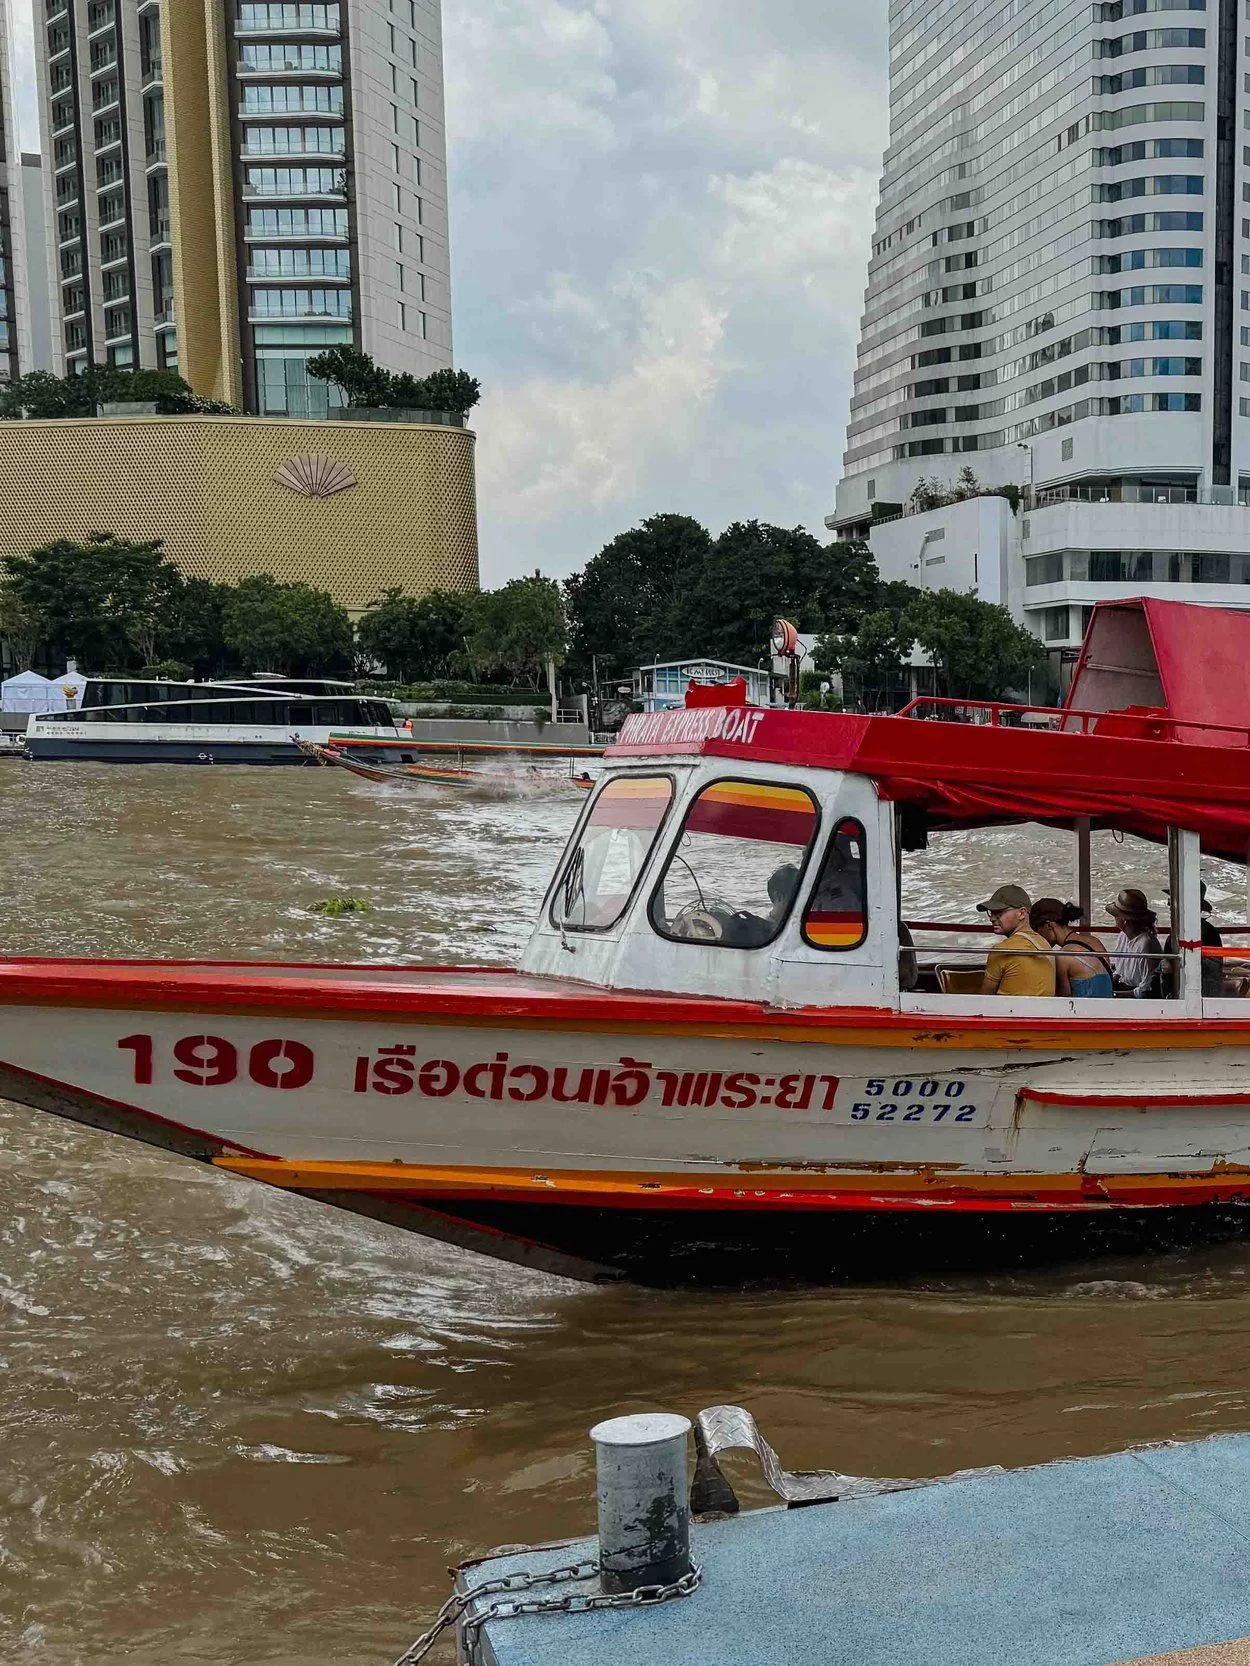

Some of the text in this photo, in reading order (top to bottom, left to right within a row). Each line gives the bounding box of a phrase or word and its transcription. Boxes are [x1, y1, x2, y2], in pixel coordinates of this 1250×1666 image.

[660, 709, 716, 742] EXPRESS
[712, 708, 765, 744] BOAT
[117, 1034, 315, 1090] 190
[353, 1043, 841, 1111] เรือด่วนเจ้าพระยา
[864, 1079, 966, 1098] 5000
[850, 1103, 977, 1123] 52272
